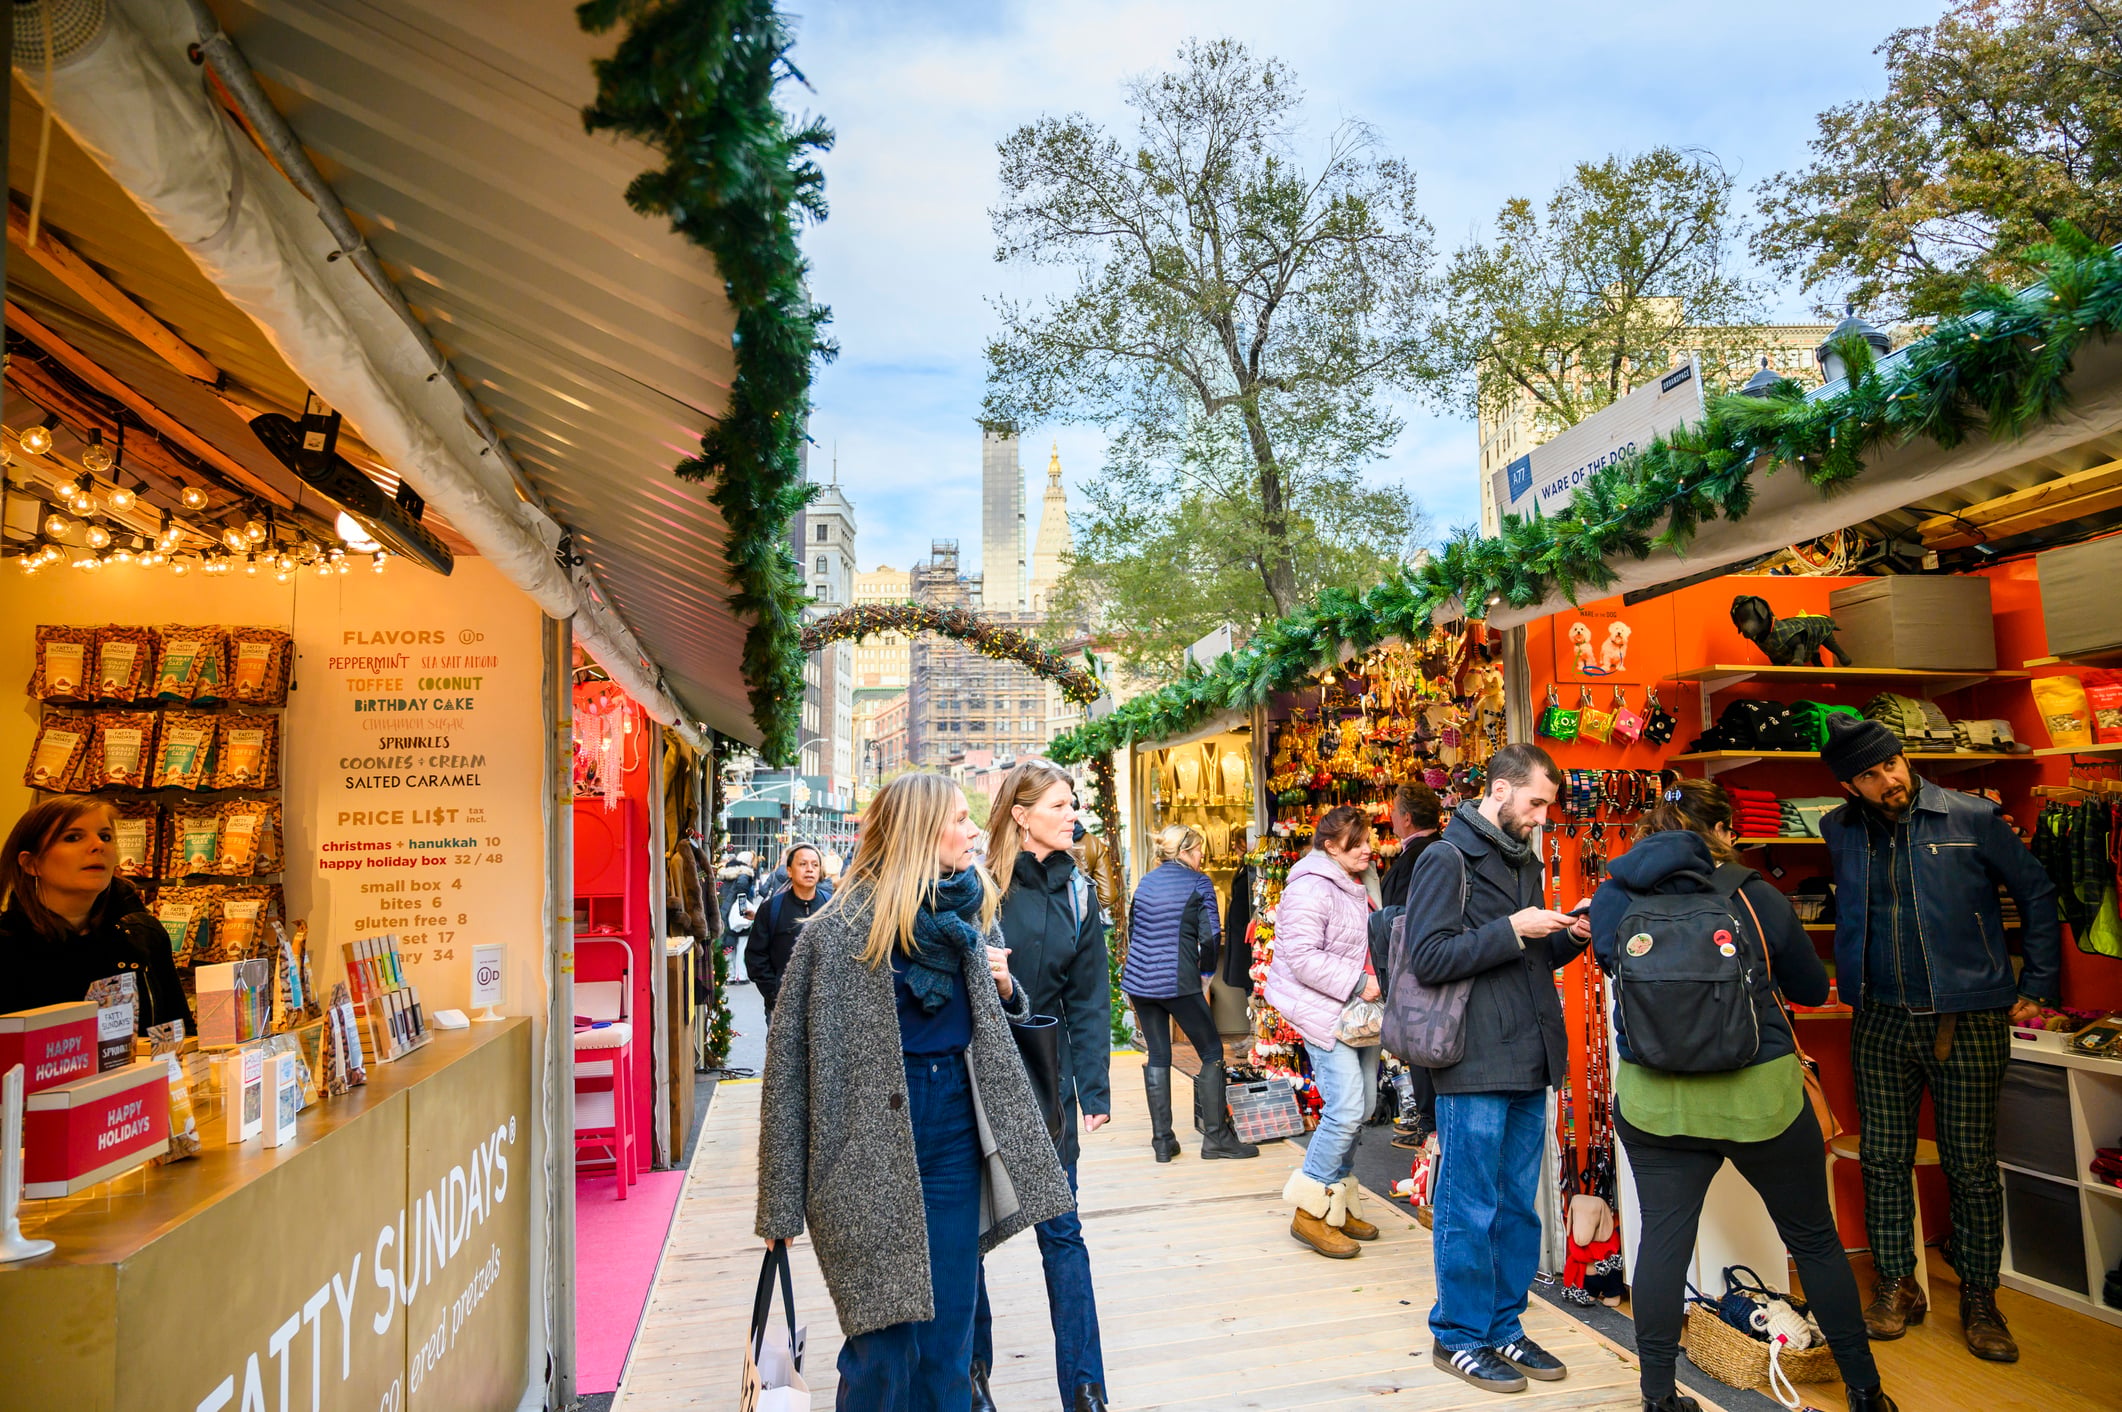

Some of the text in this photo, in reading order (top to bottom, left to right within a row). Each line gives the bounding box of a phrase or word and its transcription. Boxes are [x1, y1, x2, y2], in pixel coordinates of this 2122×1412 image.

[1513, 467, 1525, 486] A77
[1541, 442, 1636, 500] WARE OF THE DOG
[343, 630, 445, 645] FLAVORS
[329, 652, 499, 674] PEPPERMINT SEA SALT ALMOND
[346, 676, 483, 692] TOFFEE COCONUT
[433, 697, 474, 711] CAKE
[378, 736, 450, 750] SPRINKLES
[339, 755, 414, 770] COOKIES
[429, 754, 486, 769] CREAM
[345, 774, 481, 790] SALTED CARAMEL
[337, 806, 459, 826] PRICE LI$T
[466, 815, 487, 823] incl.
[322, 837, 501, 851] christmas + hanukkah 10
[319, 853, 503, 870] happy holiday box 32 / 48
[360, 878, 463, 894] small box 4
[380, 896, 442, 910] bites 6
[354, 913, 468, 931] gluten free 8
[402, 931, 455, 945] set 17
[433, 949, 454, 962] 34
[104, 1011, 123, 1020] FATTY
[45, 1035, 82, 1059] HAPPY
[35, 1053, 89, 1081] HOLIDAYS
[107, 1099, 143, 1127] HAPPY
[98, 1116, 150, 1151] HOLIDAYS
[196, 1252, 362, 1412] TTY
[380, 1243, 501, 1412] coered pretzels
